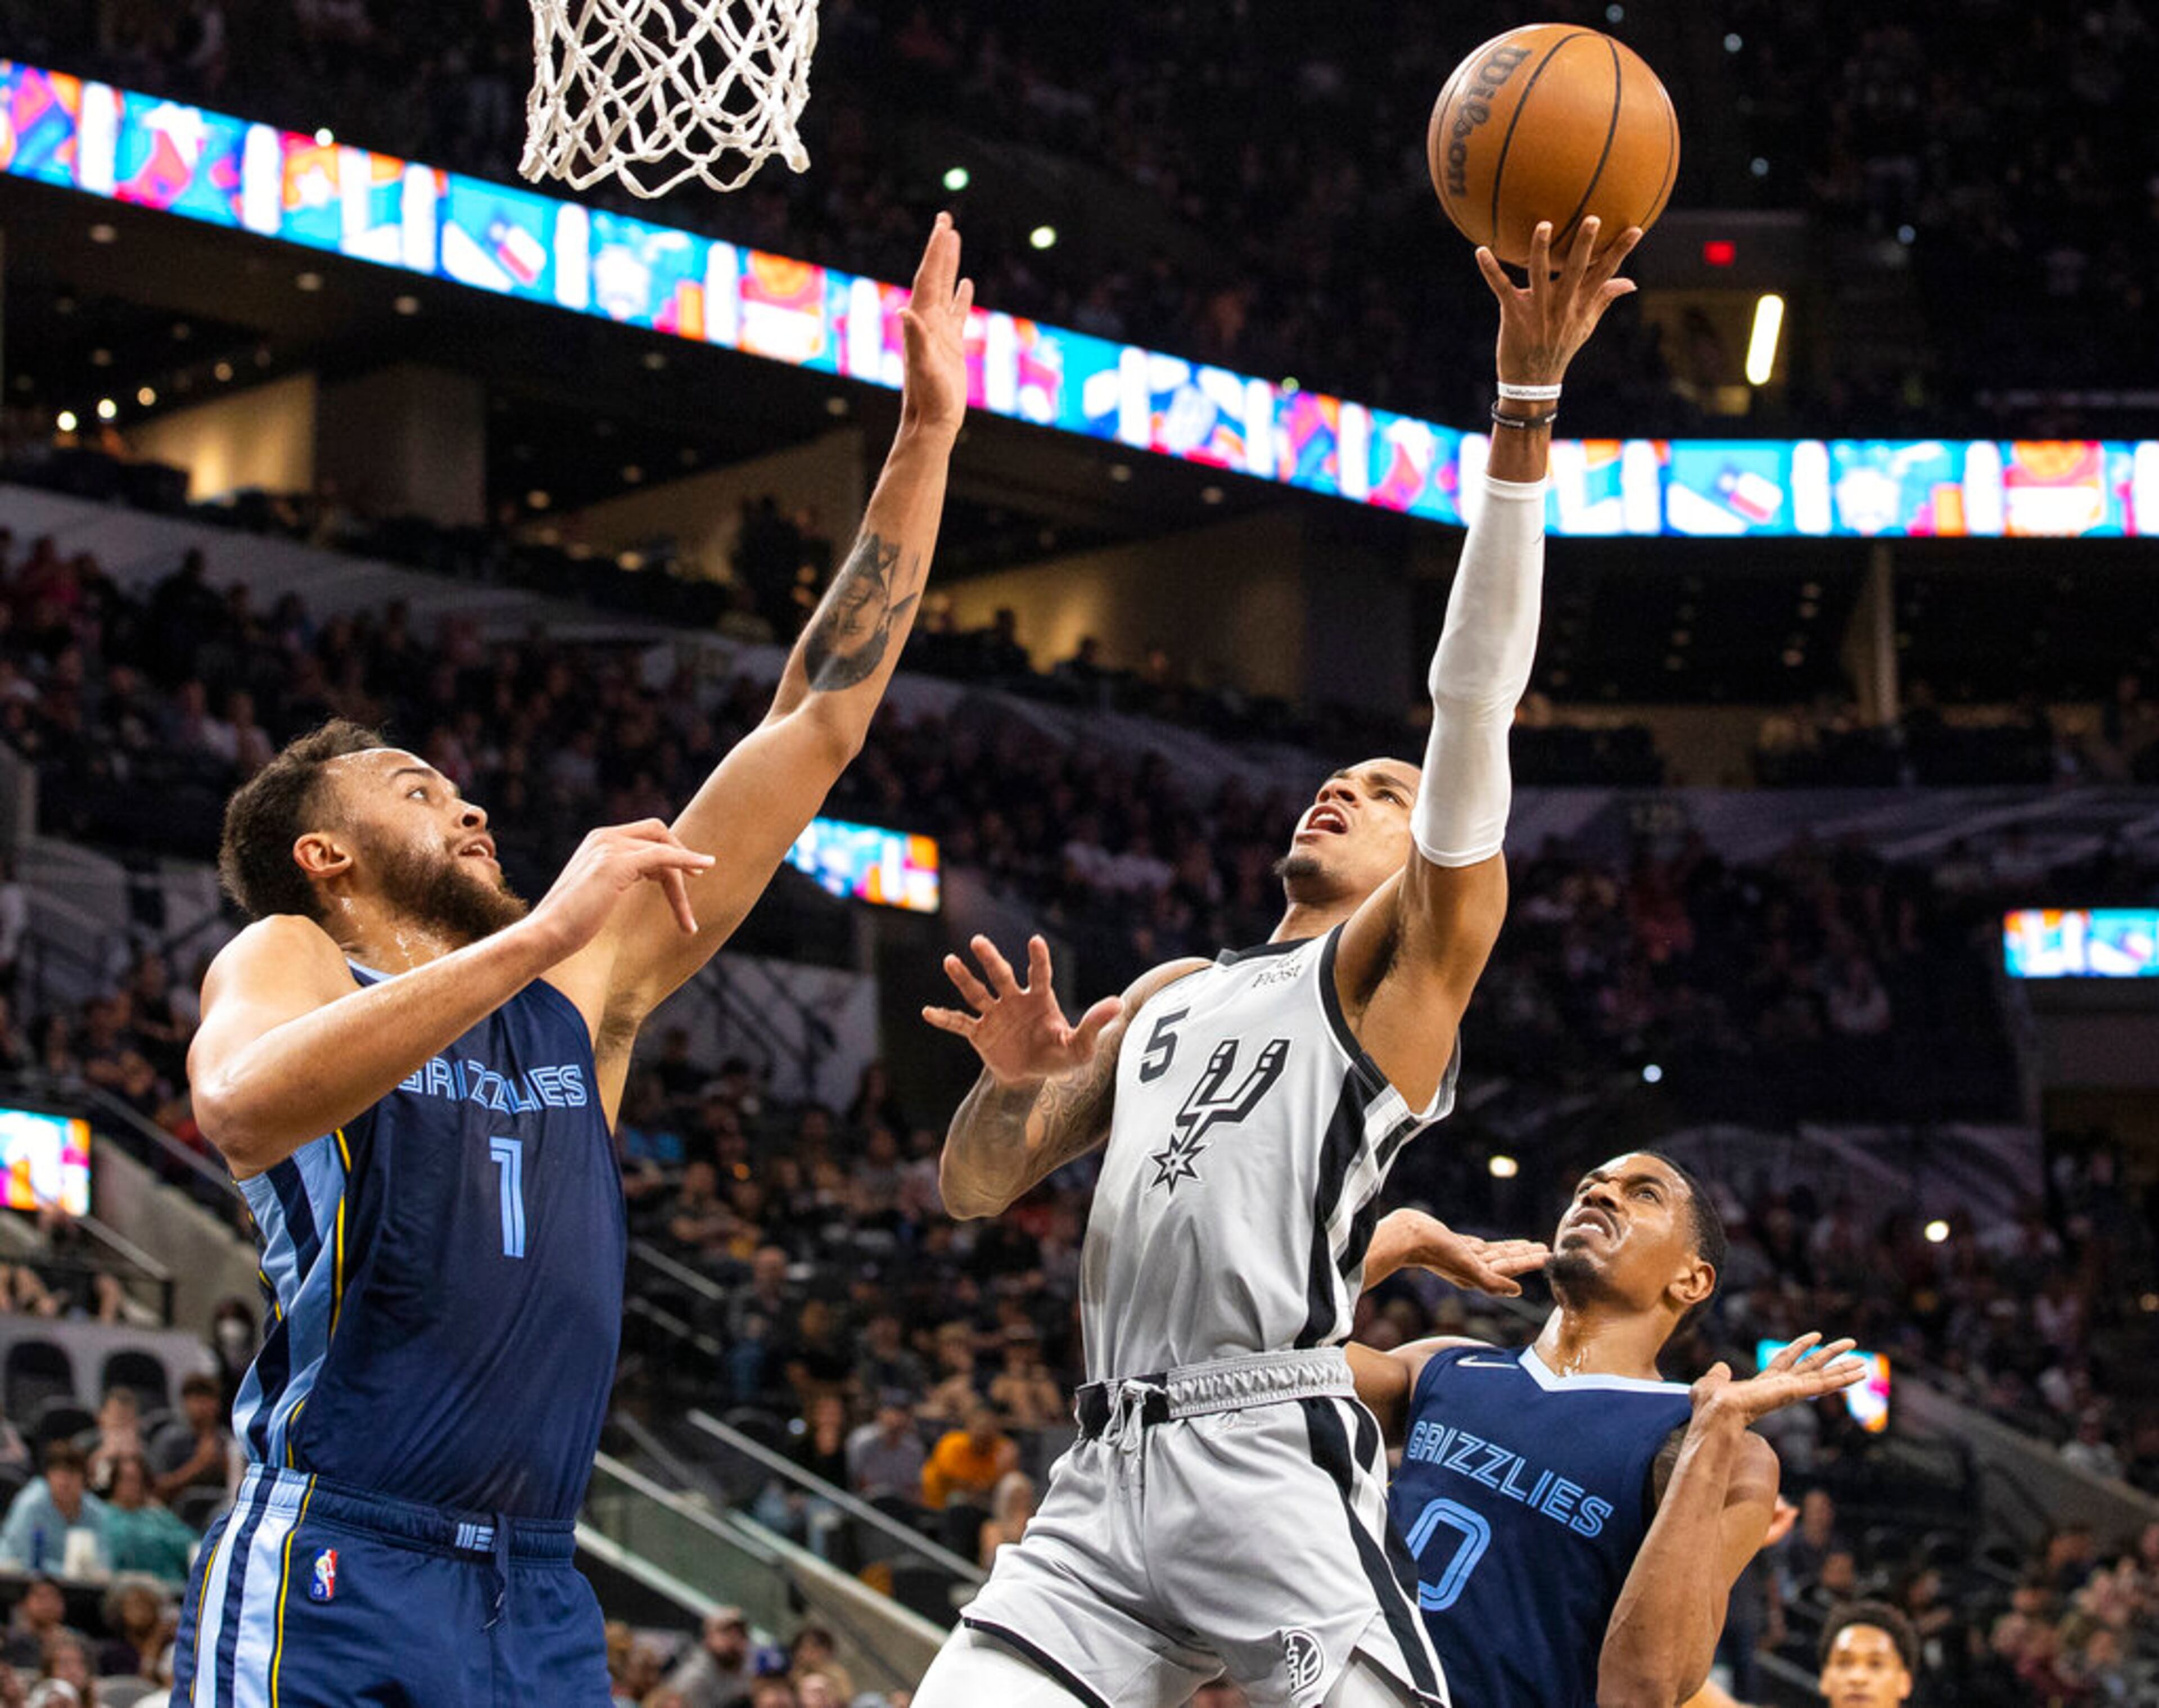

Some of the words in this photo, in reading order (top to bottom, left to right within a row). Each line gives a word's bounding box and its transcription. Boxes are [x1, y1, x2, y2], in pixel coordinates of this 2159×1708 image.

[1448, 44, 1532, 198] Wilson
[1140, 1006, 1190, 1083] 5
[490, 1136, 526, 1258] 1
[1407, 1420, 1614, 1538] GRIZZLIES
[1406, 1497, 1491, 1612] 0
